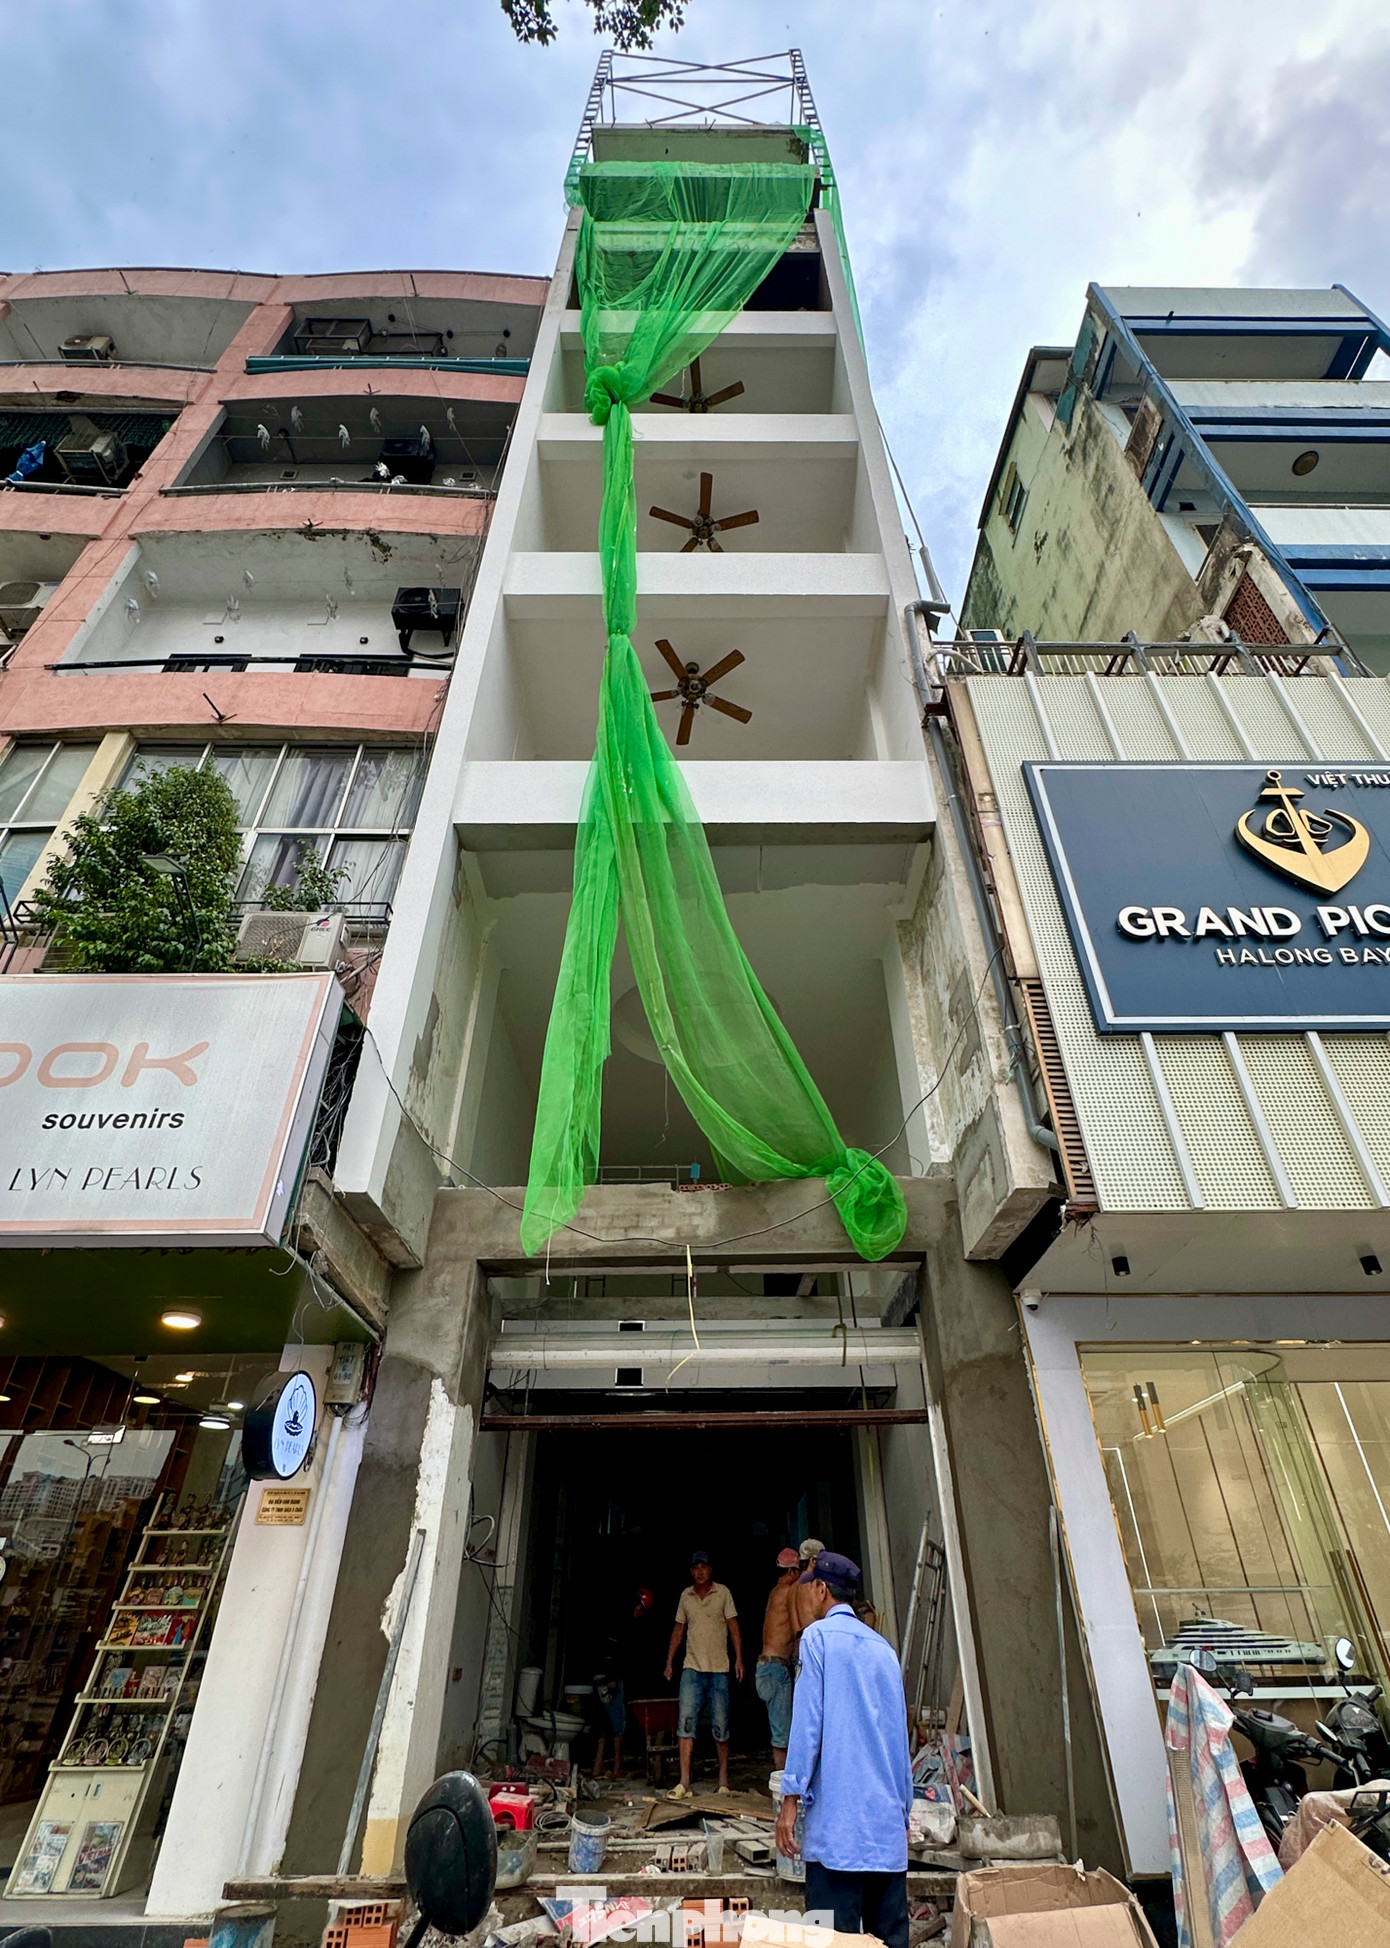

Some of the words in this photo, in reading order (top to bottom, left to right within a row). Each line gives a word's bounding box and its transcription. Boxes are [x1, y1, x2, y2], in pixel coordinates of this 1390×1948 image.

[1304, 770, 1346, 788] VIỆT
[1117, 906, 1302, 937] GRAND
[1216, 948, 1333, 965] HALONG
[1337, 947, 1390, 965] BAY
[41, 1108, 186, 1131] souvenirs
[8, 1167, 72, 1192] LYN
[81, 1165, 203, 1191] PEARLS
